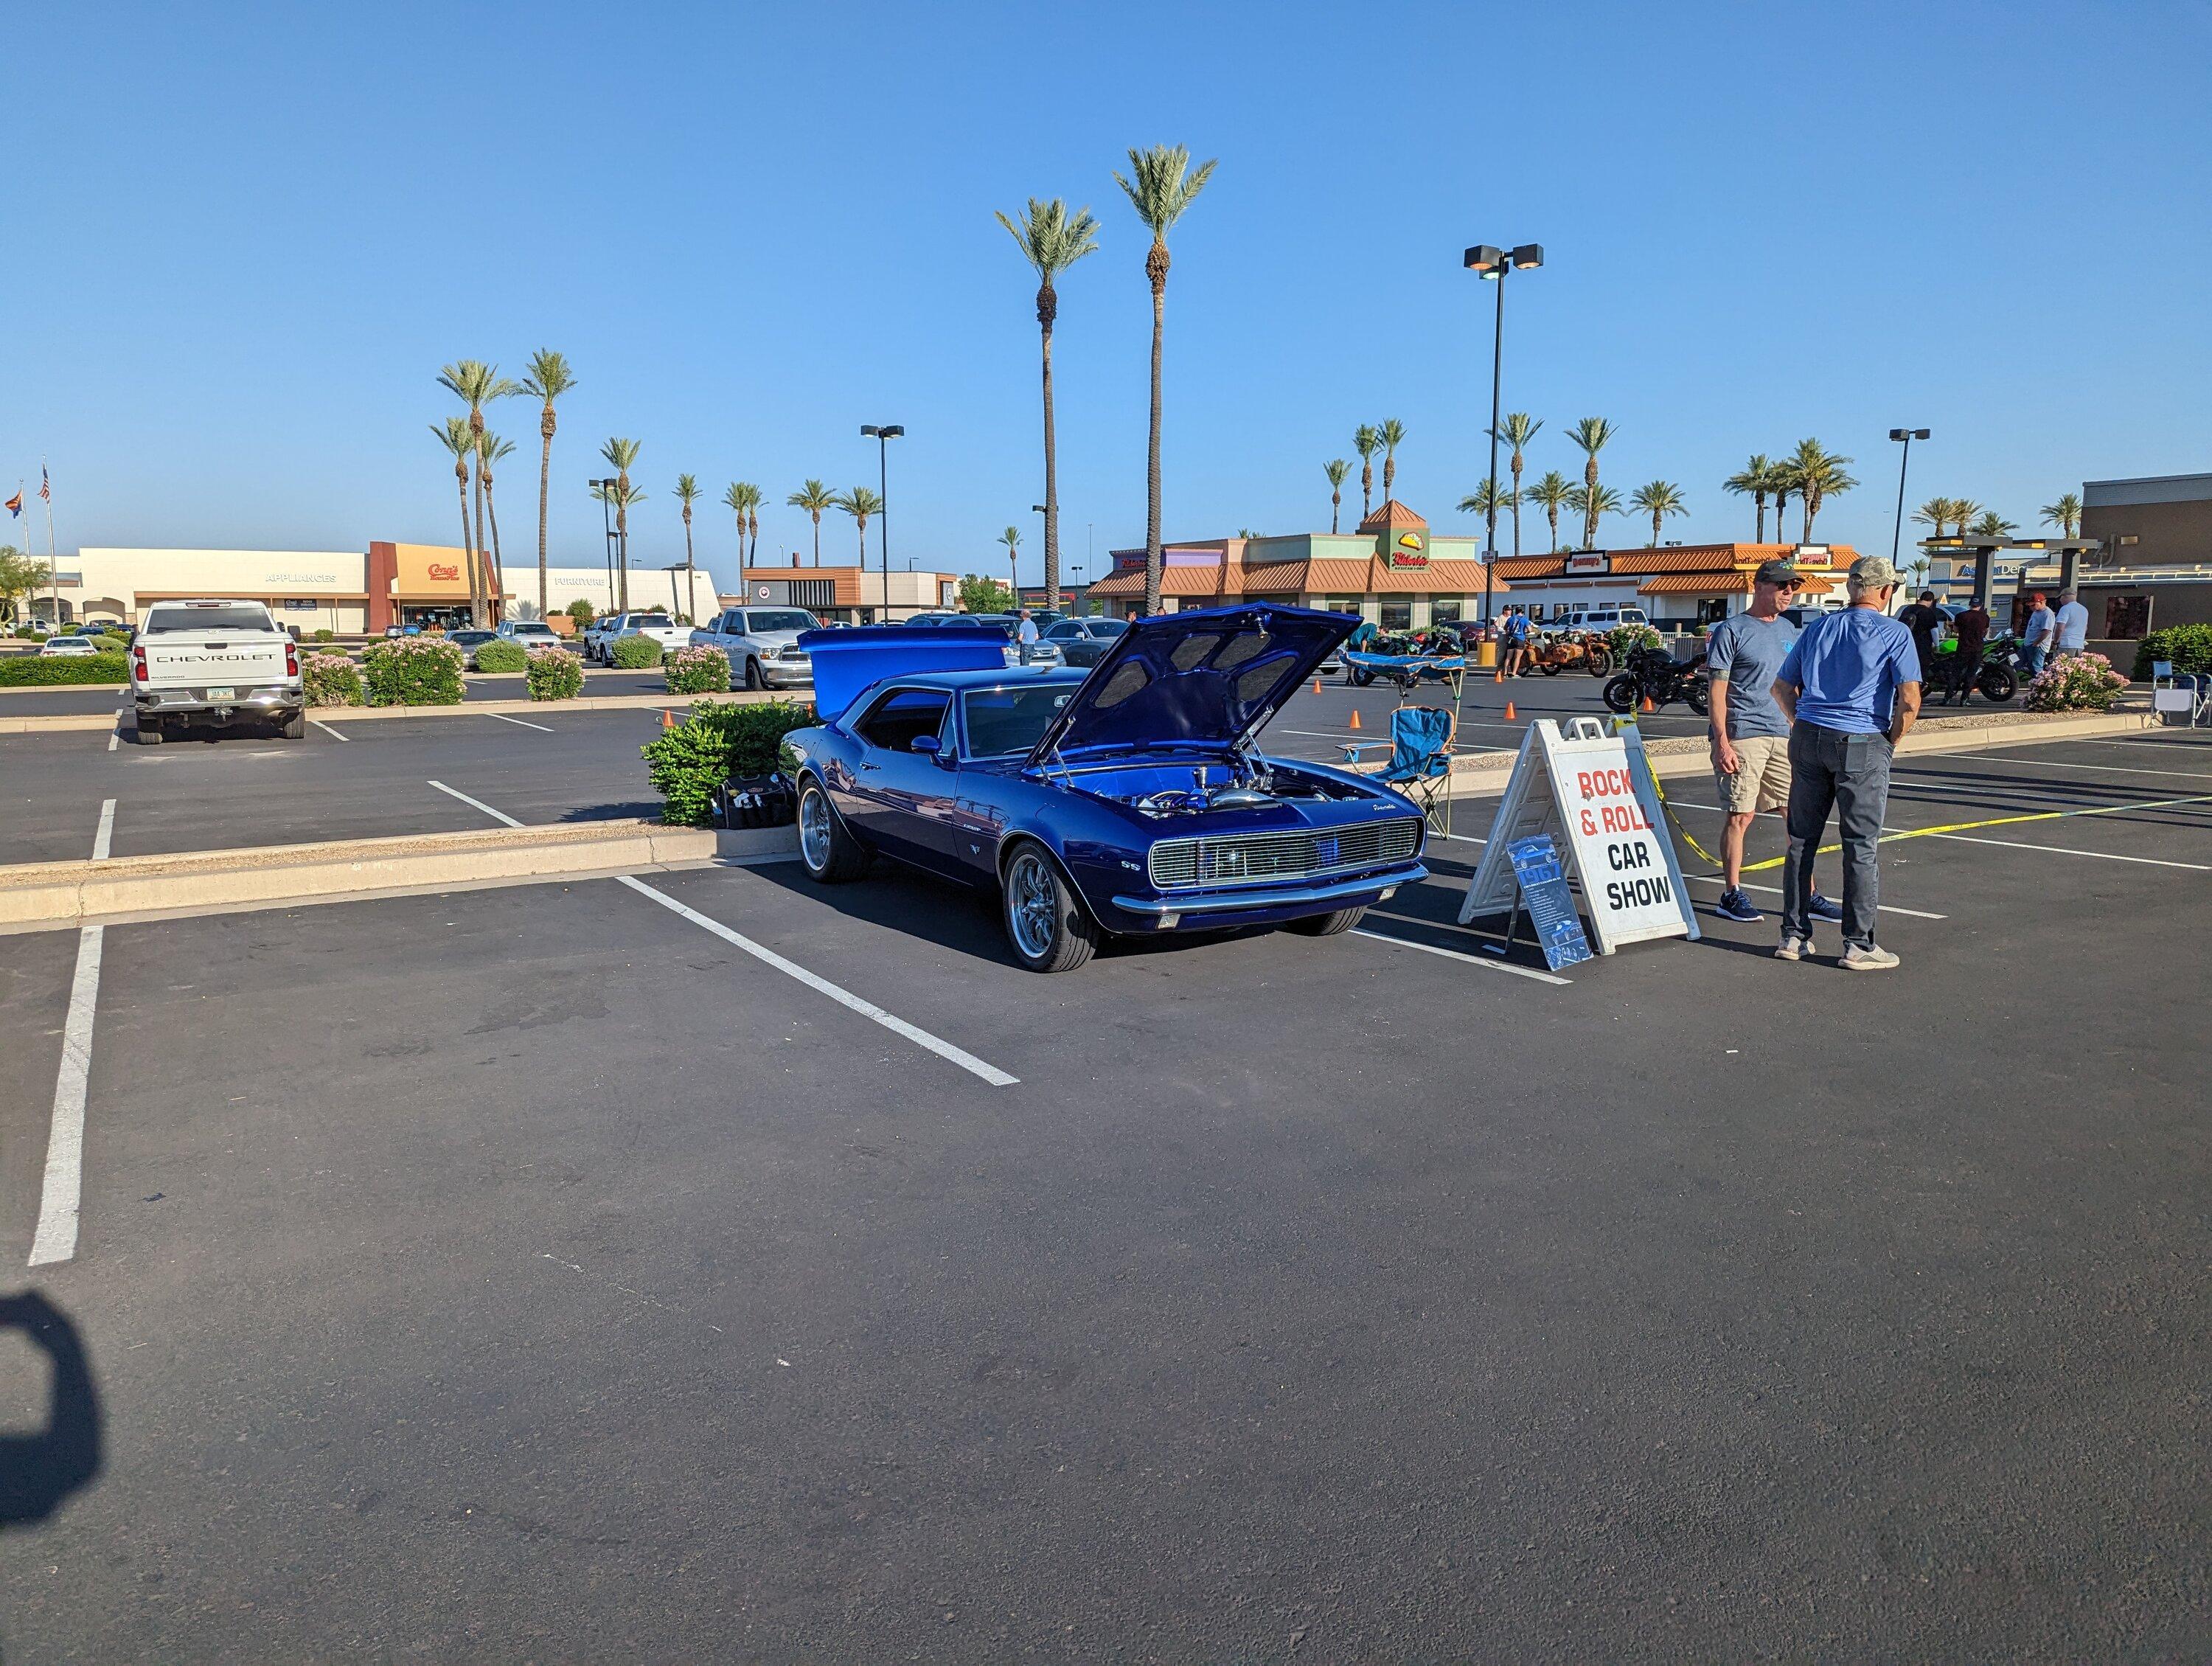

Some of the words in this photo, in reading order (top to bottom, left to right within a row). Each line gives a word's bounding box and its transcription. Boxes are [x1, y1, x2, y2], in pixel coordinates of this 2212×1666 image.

[265, 573, 337, 583] APPLIANCES
[554, 577, 605, 586] FURNITURE
[156, 654, 276, 663] CHEVROLET
[1577, 768, 1636, 797] ROCK
[1580, 809, 1599, 836] &
[1601, 804, 1655, 833] ROLL
[1121, 860, 1141, 871] SS
[1607, 841, 1651, 871] CAR
[1517, 862, 1561, 886] 1967
[1607, 876, 1671, 911] SHOW
